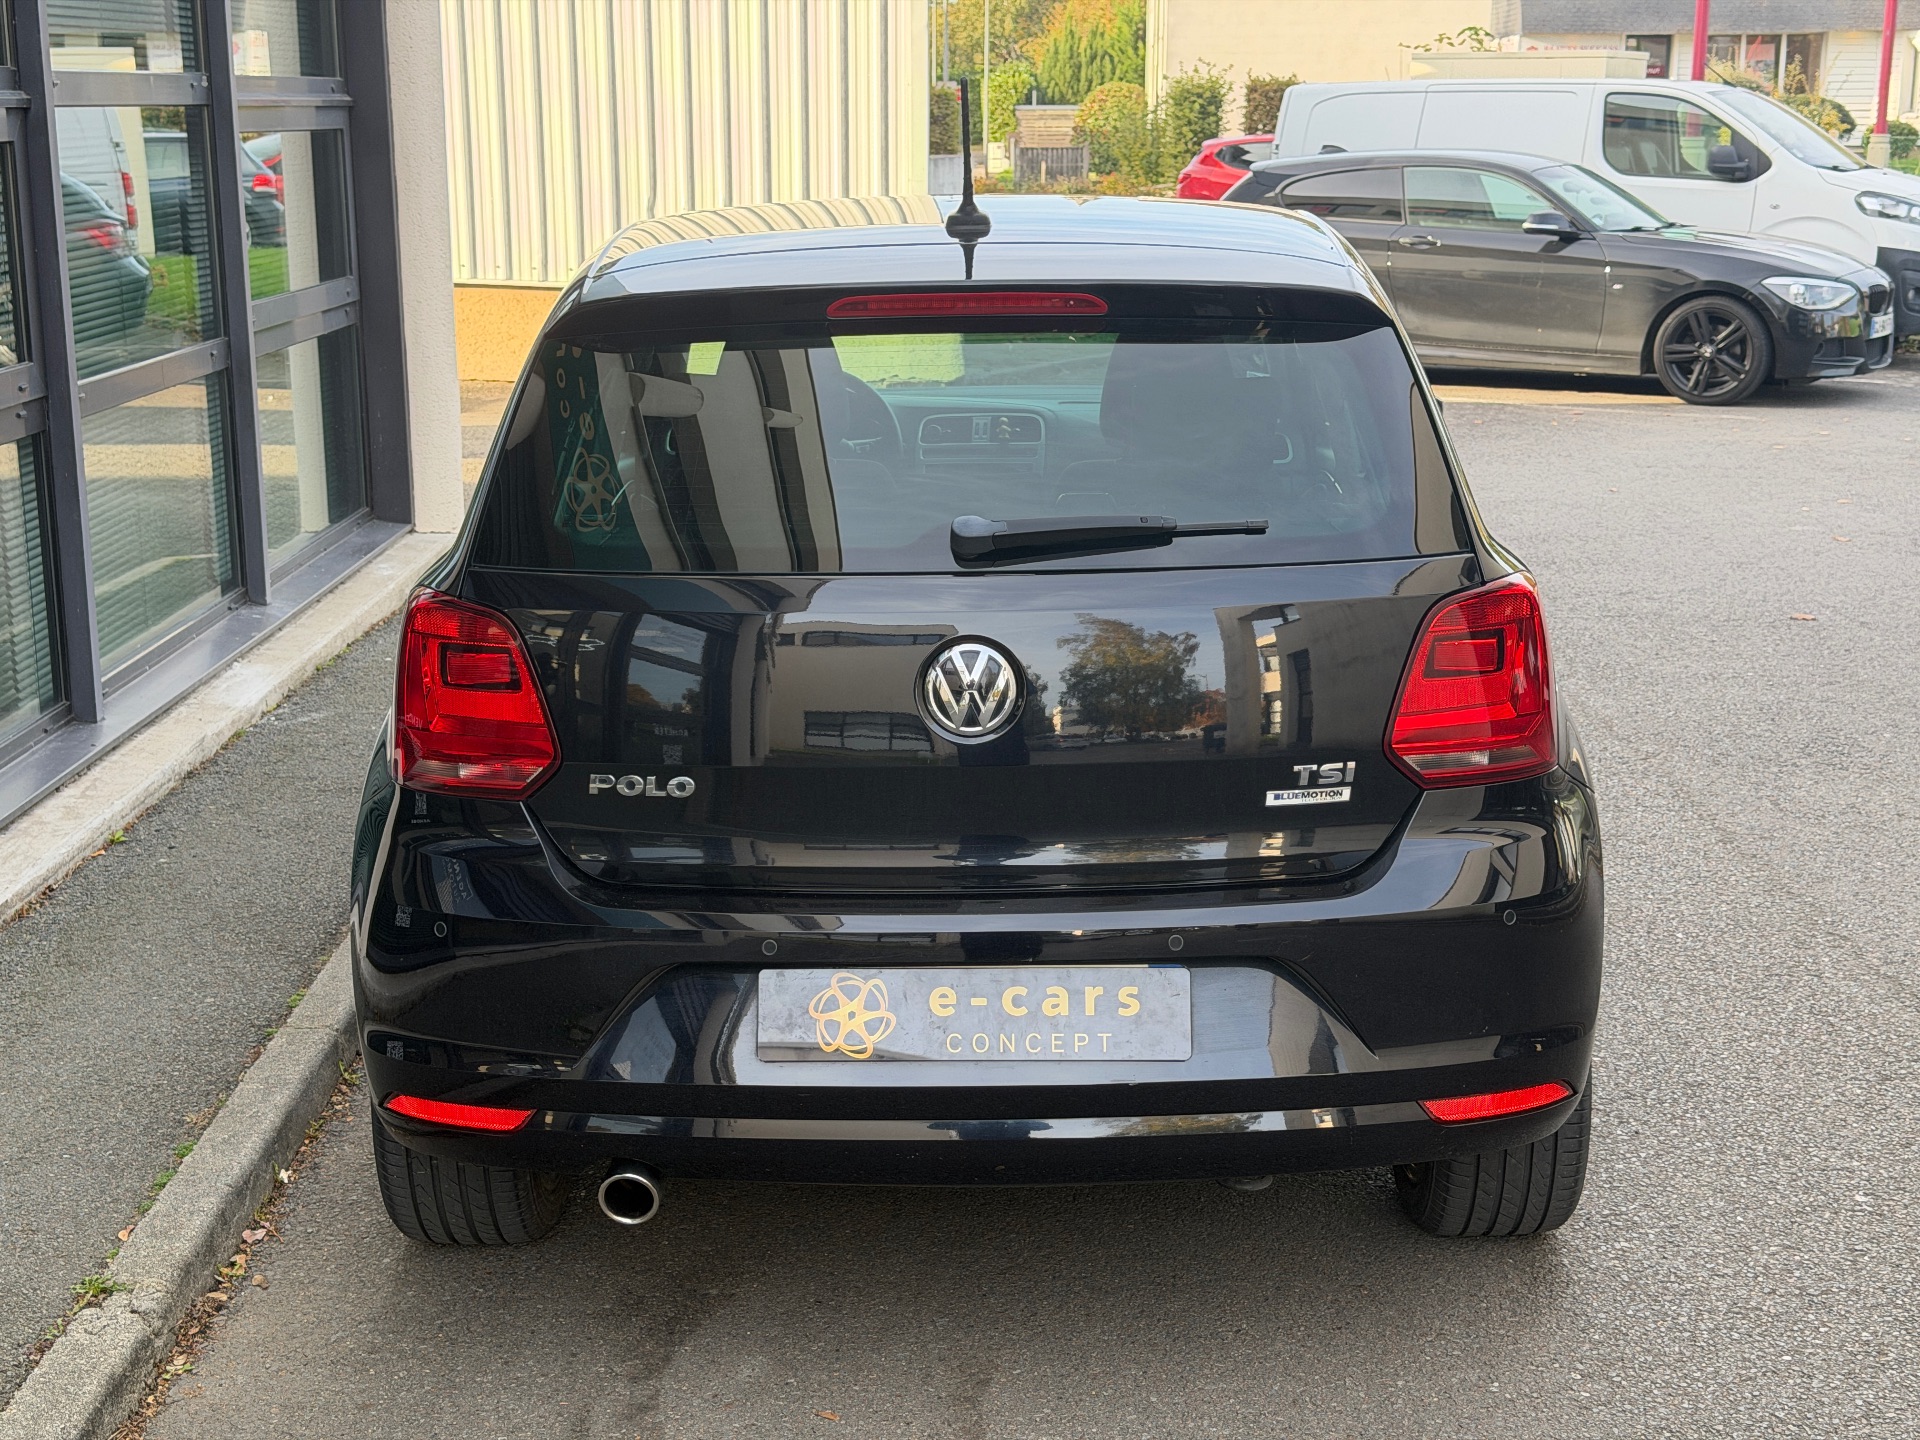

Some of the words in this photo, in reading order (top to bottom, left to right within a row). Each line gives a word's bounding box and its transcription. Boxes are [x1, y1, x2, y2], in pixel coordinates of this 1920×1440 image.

[588, 773, 696, 799] POLO
[1292, 761, 1356, 786] TSI
[1273, 790, 1343, 801] BLUEMOTION
[929, 985, 1141, 1017] e-cars
[946, 1033, 1114, 1053] CONCEPT
